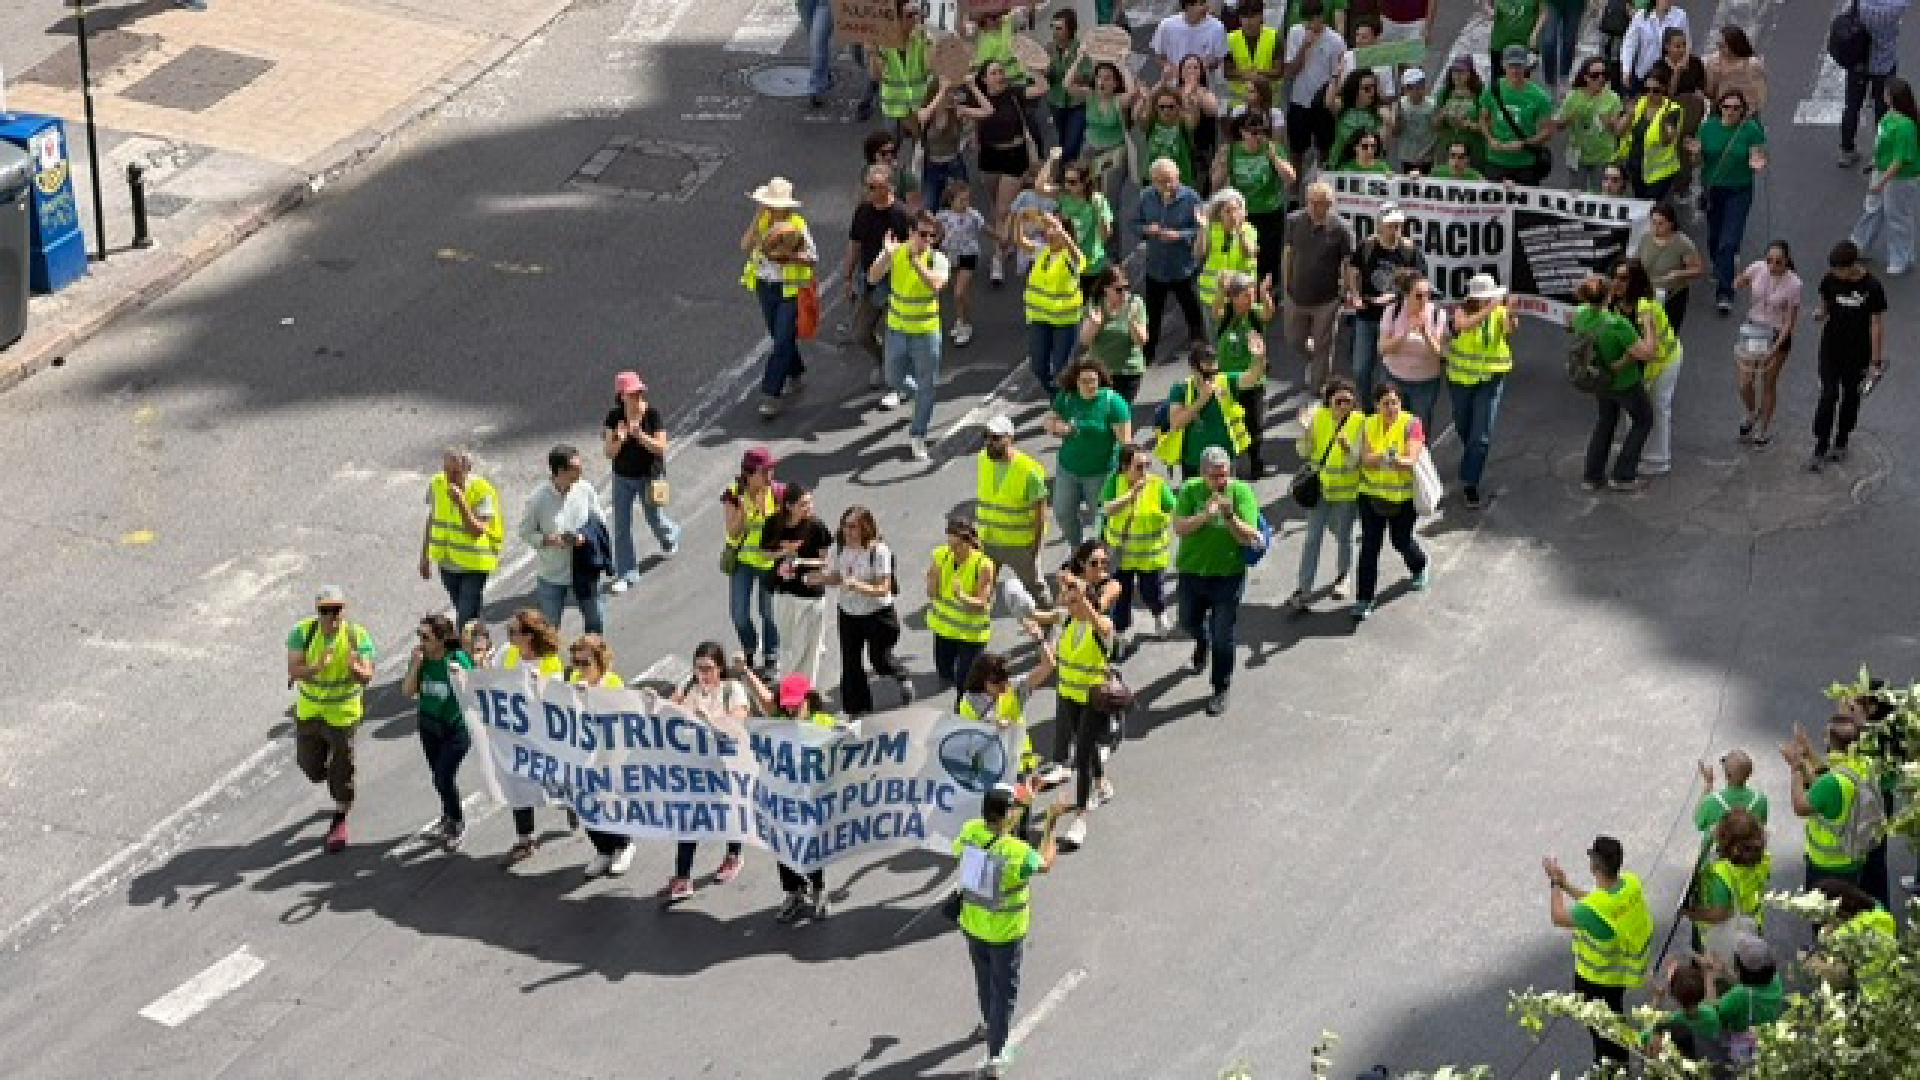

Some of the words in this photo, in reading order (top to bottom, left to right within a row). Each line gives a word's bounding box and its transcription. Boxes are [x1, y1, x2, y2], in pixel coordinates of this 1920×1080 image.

[1338, 212, 1505, 257] DCACIÓ
[474, 688, 531, 734] IES
[542, 700, 740, 757] DISTRICTE
[749, 728, 911, 784] MARÍTIM
[512, 743, 560, 786] PER
[842, 773, 956, 813] PÚBLIC
[575, 789, 731, 833] QUALITAT
[738, 803, 748, 834] I
[784, 801, 926, 865] VALENCIÀ
